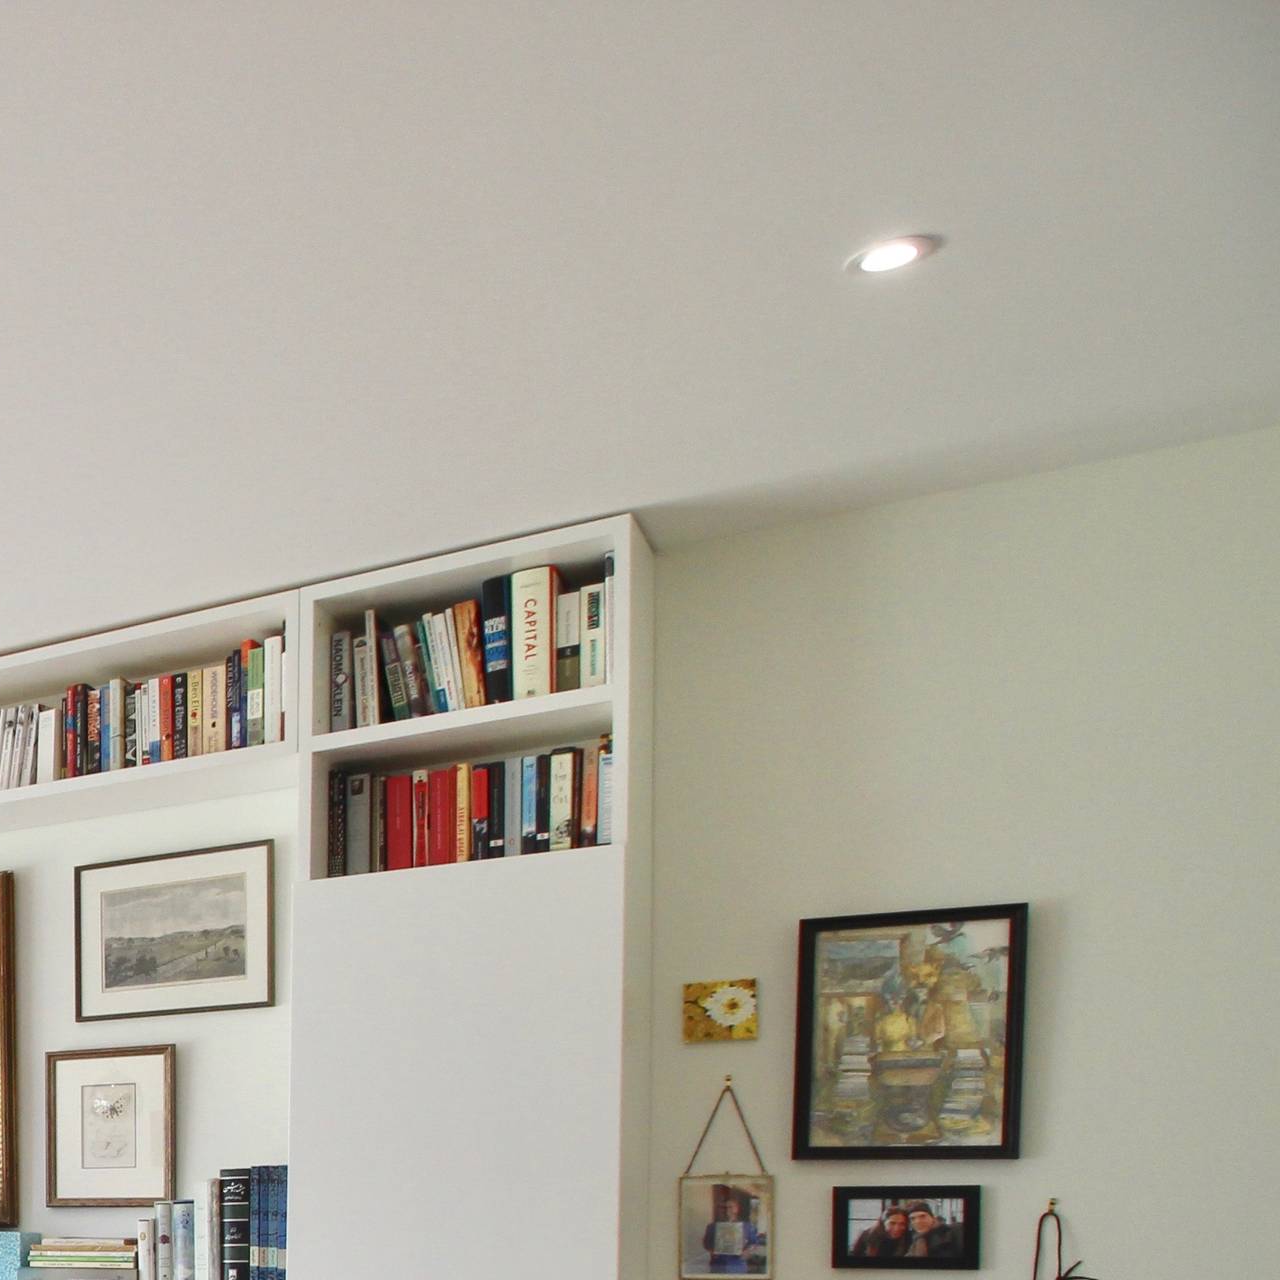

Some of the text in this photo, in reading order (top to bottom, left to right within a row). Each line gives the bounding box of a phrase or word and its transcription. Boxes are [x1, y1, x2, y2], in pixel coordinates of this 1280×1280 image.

[524, 598, 538, 661] CAPITAL
[175, 687, 184, 731] Ben Elton
[191, 681, 199, 699] Ben
[210, 671, 218, 719] WODEHOUSE
[334, 684, 343, 717] KLEIN
